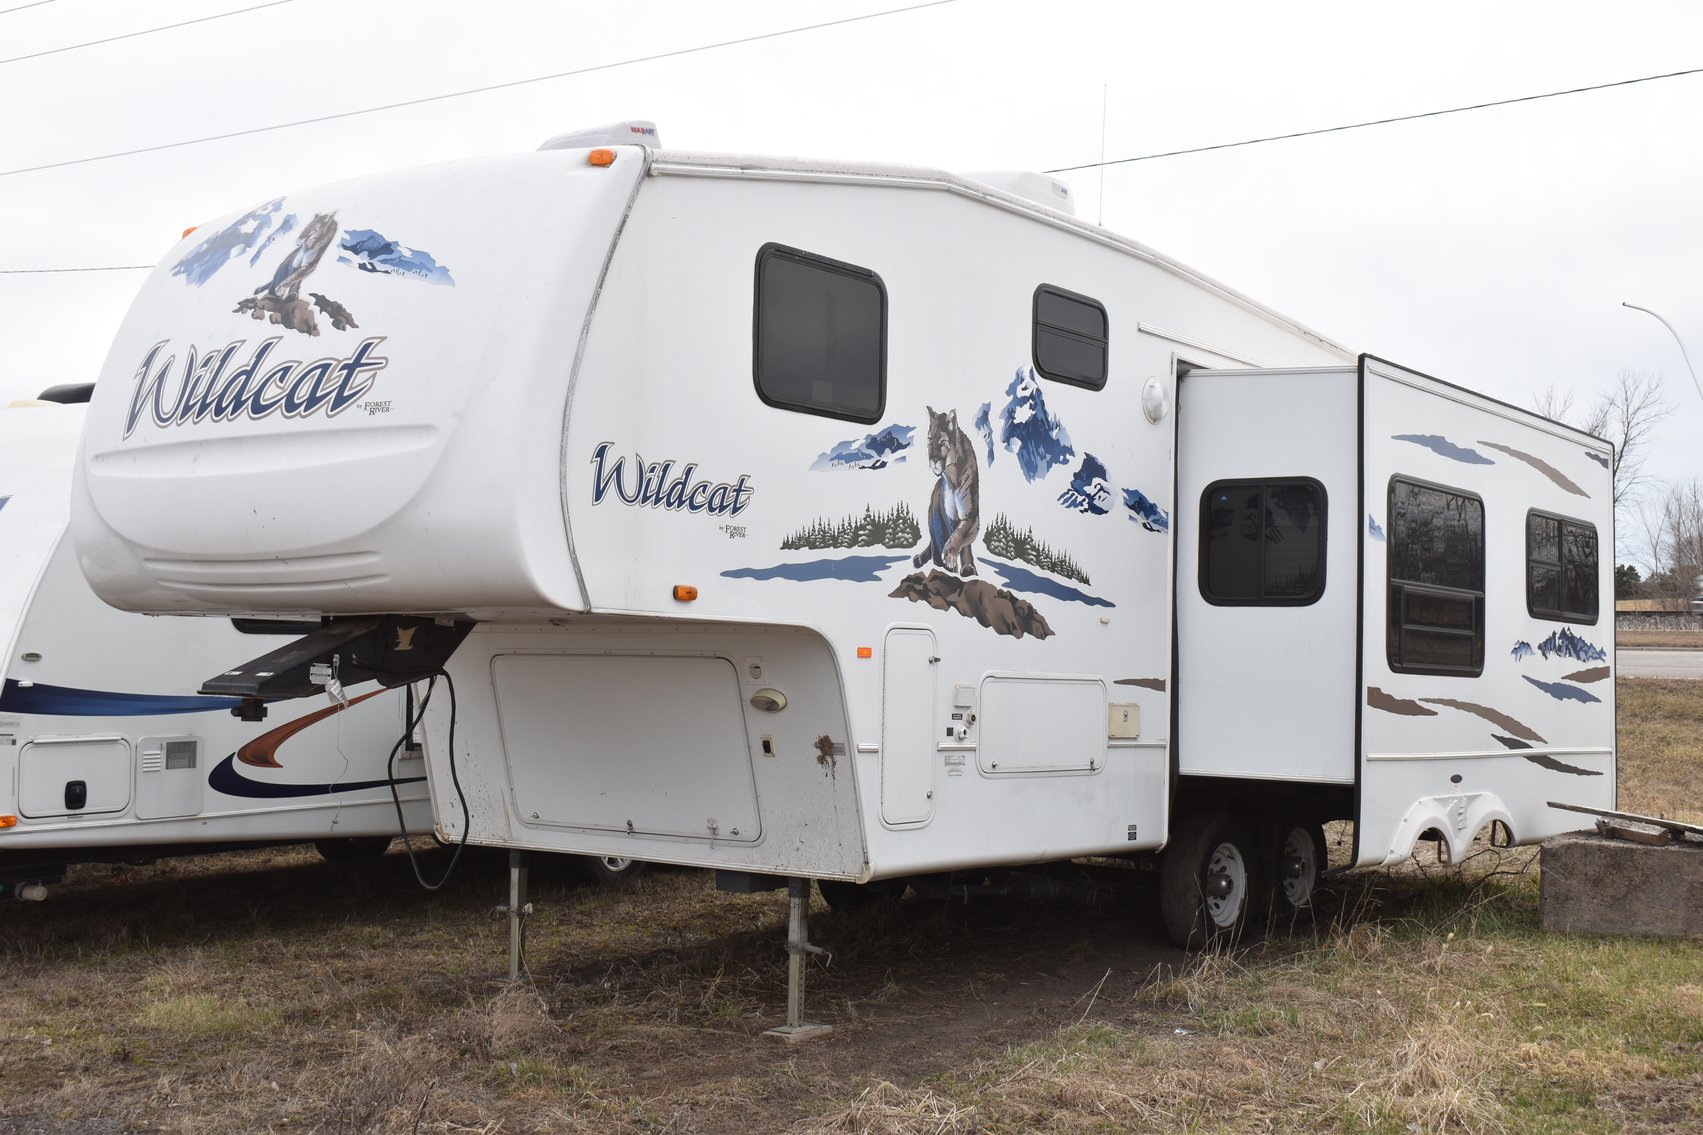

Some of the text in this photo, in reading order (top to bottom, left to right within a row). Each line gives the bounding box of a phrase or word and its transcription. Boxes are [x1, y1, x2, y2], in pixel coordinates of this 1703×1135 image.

[123, 336, 389, 441] Wildcat
[364, 400, 392, 410] FOREST
[369, 406, 391, 416] RIVER
[590, 441, 754, 518] Wildcat
[725, 524, 746, 533] FOREST
[729, 531, 746, 539] RIVER
